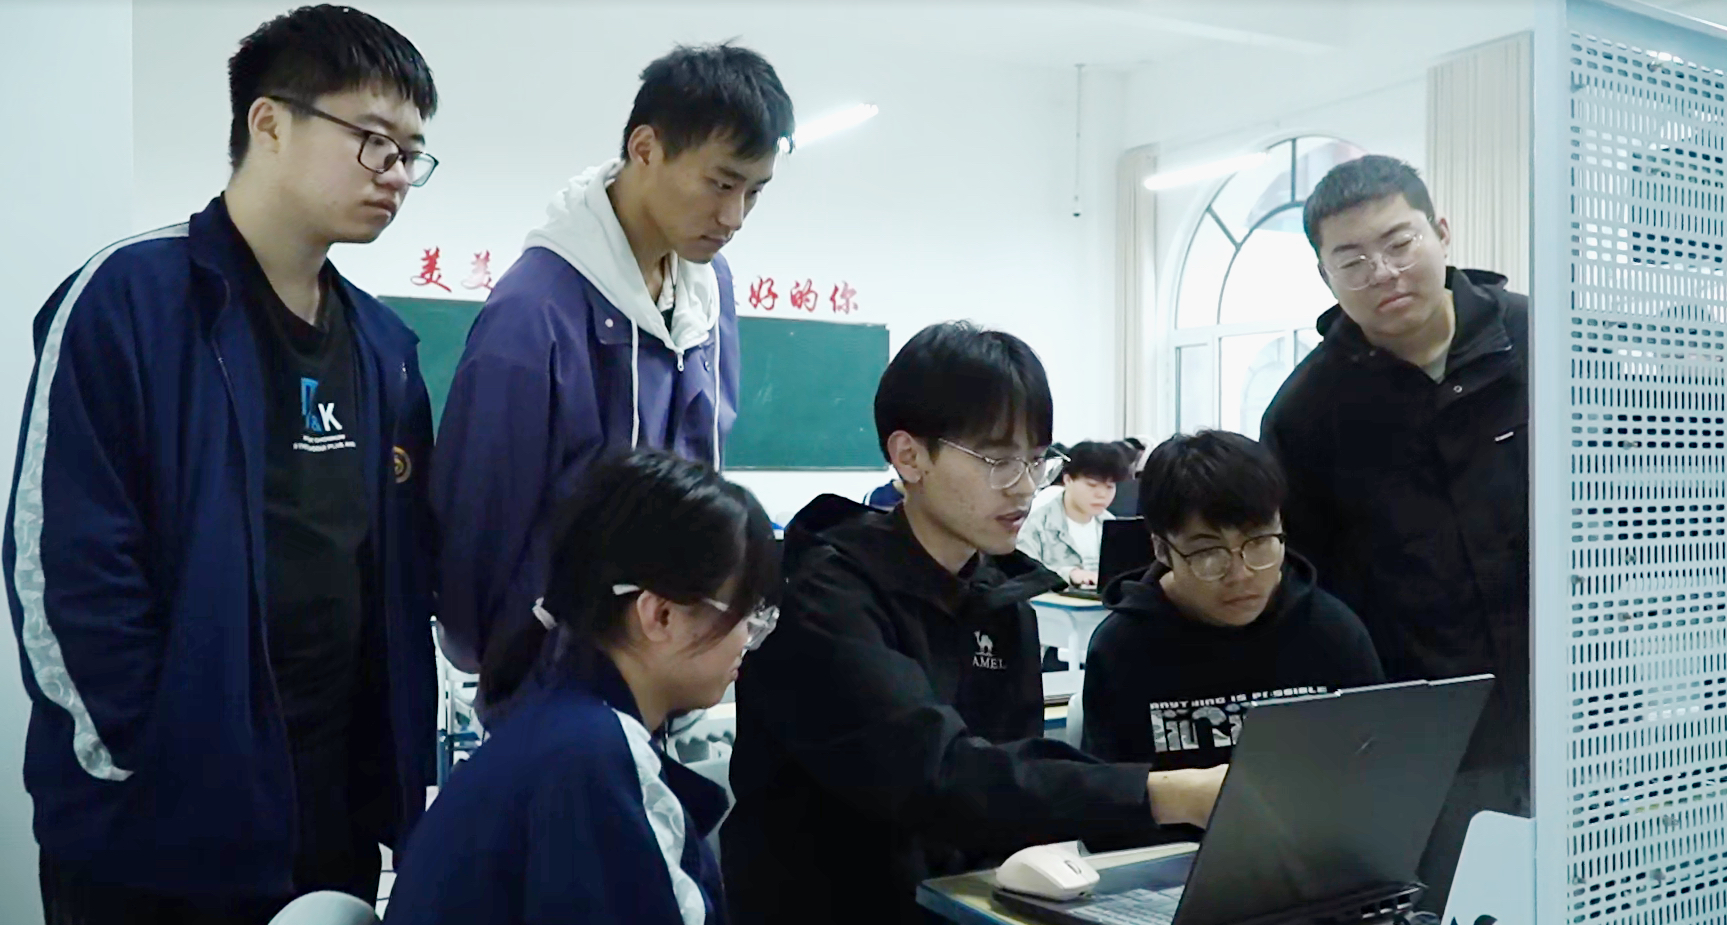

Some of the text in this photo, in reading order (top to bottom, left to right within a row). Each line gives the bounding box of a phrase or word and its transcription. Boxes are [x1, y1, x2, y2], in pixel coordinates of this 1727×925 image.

[734, 275, 859, 315] 好的你
[1230, 693, 1248, 703] IS
